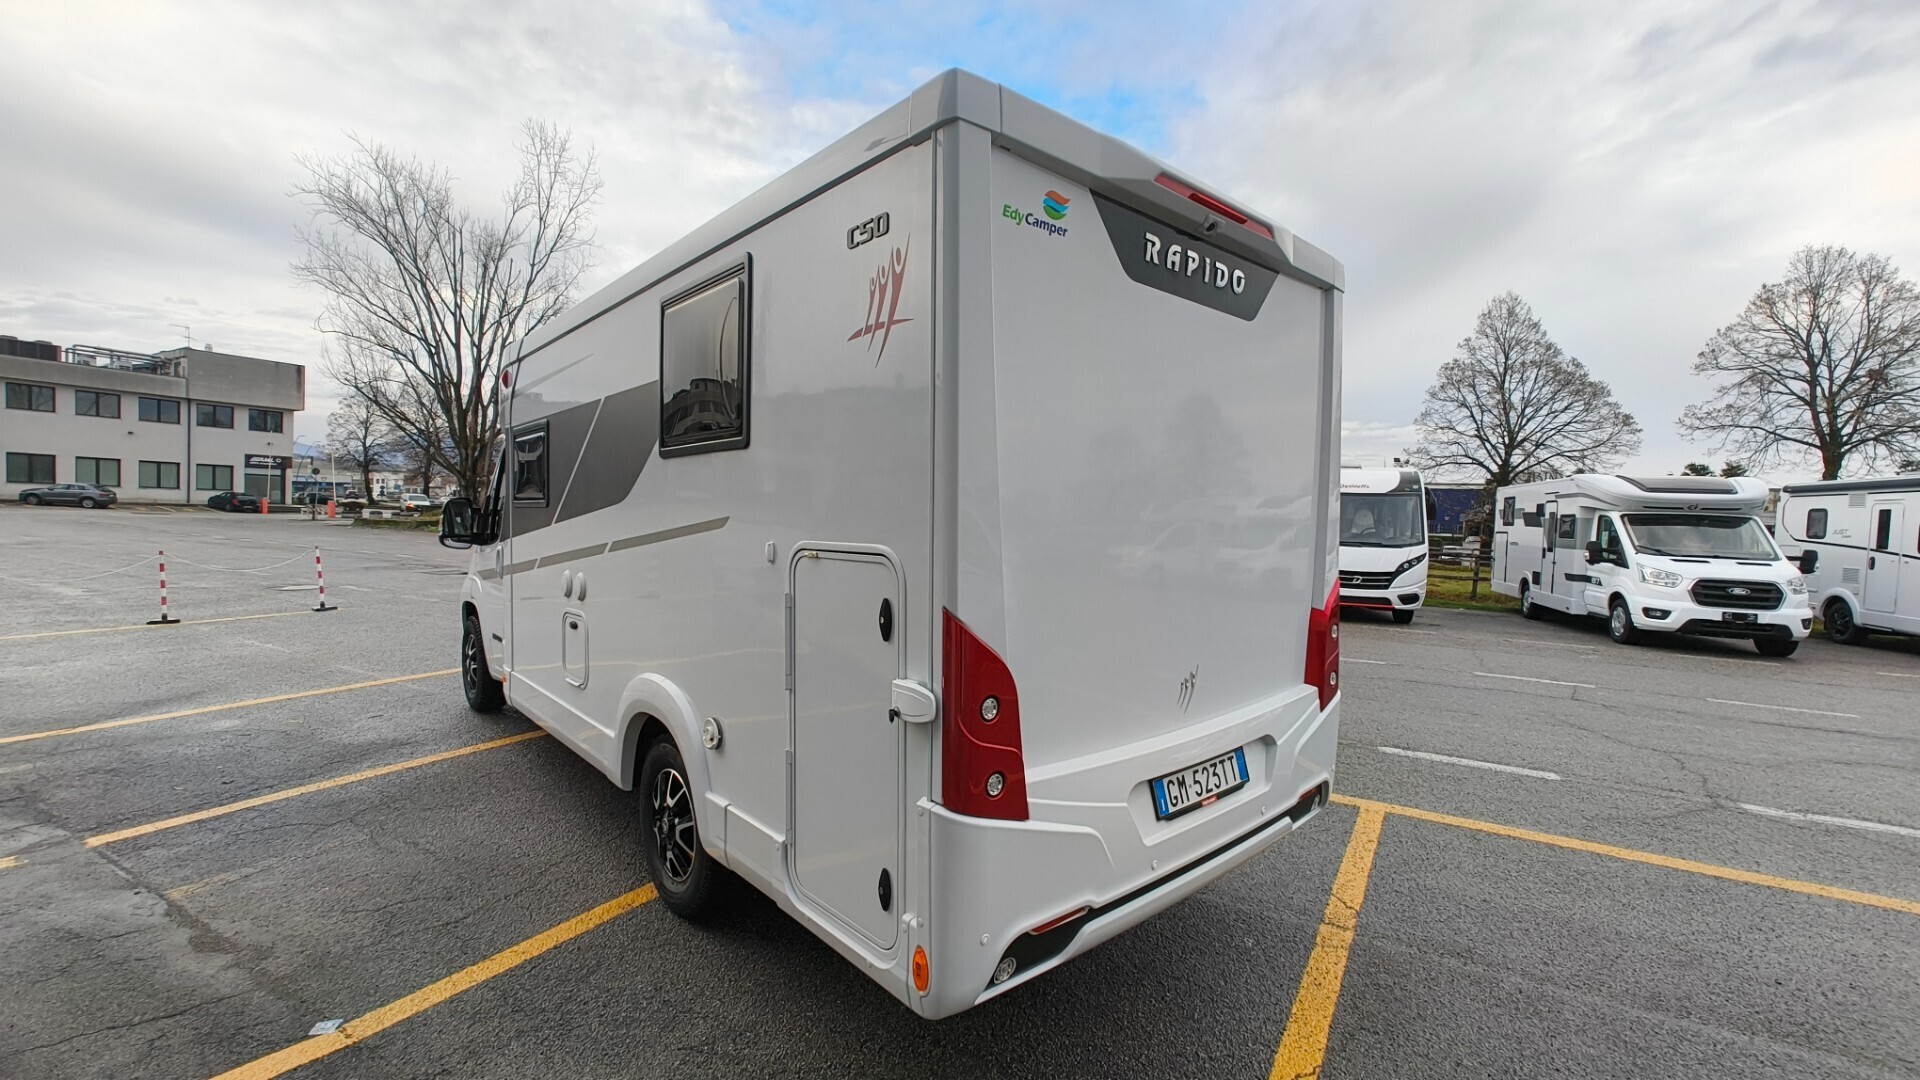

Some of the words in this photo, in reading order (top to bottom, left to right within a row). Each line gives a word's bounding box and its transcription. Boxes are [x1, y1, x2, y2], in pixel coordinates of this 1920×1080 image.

[846, 211, 890, 250] C50
[1143, 231, 1246, 296] RAPIDO
[1166, 774, 1190, 807] GM
[1192, 755, 1237, 797] 523TT
